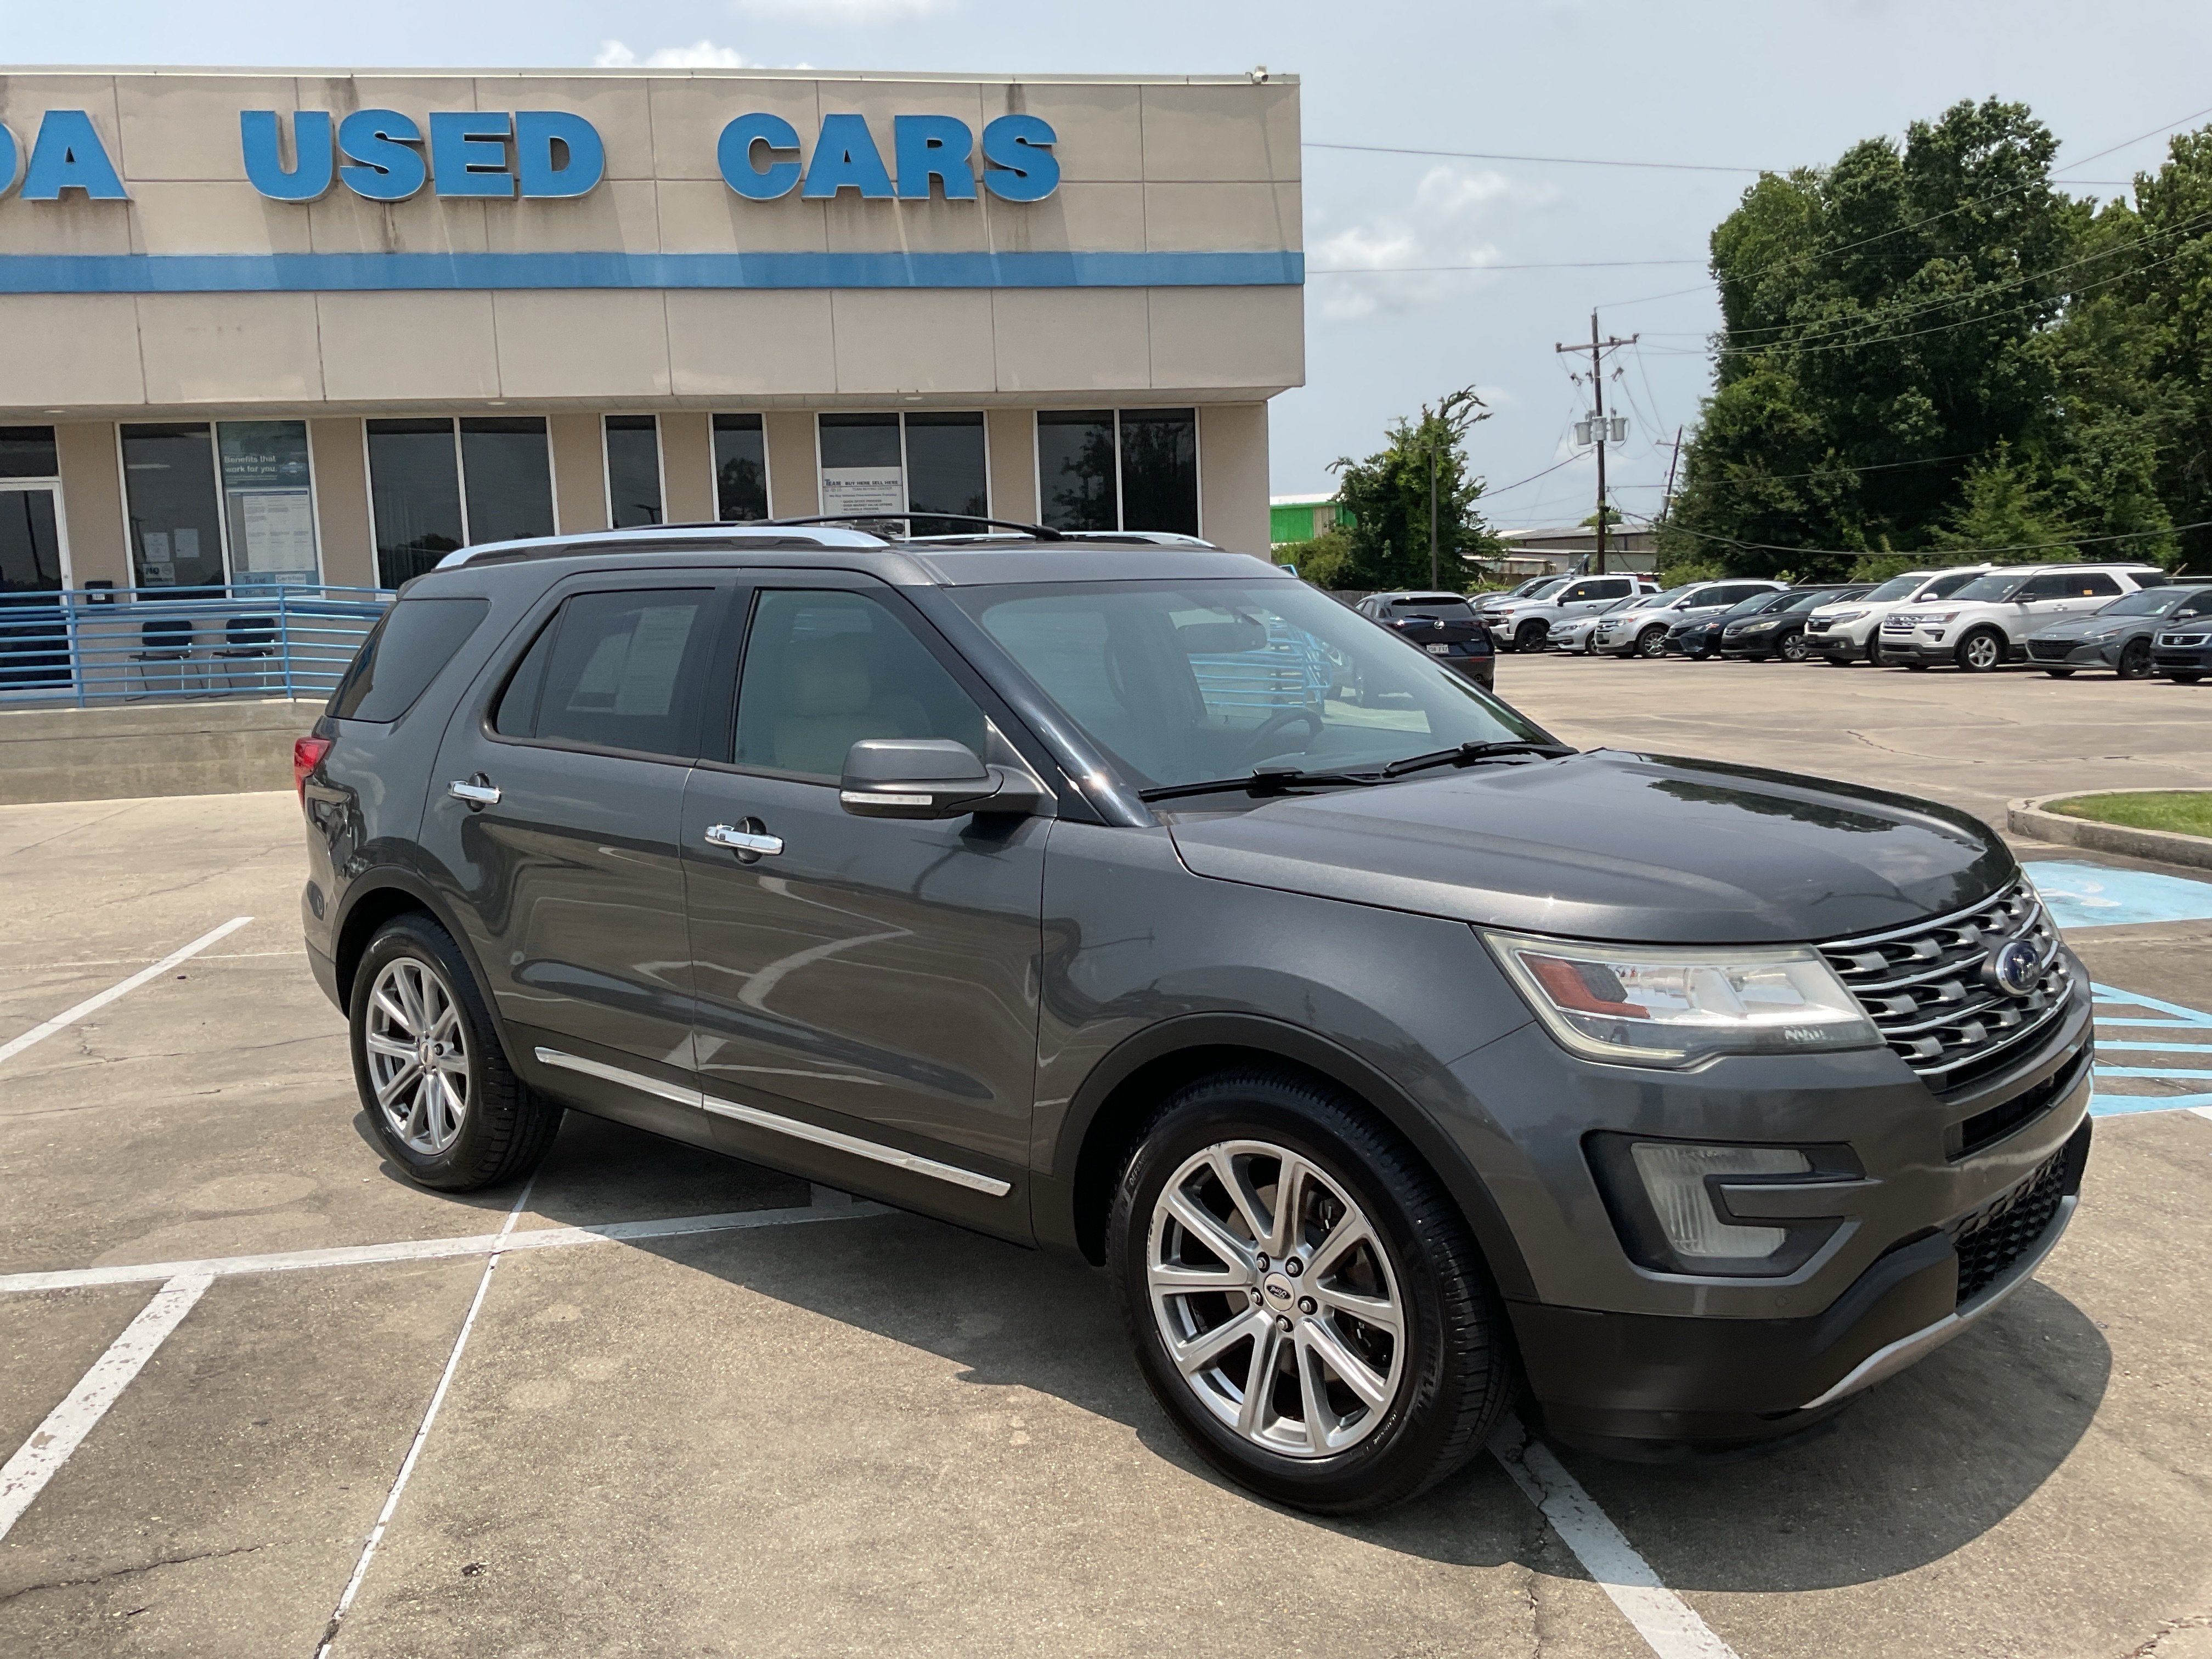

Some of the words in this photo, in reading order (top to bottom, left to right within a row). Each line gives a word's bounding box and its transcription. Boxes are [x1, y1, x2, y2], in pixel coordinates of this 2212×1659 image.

[0, 110, 129, 200] A
[240, 109, 605, 200] USED
[718, 112, 1060, 201] CARS
